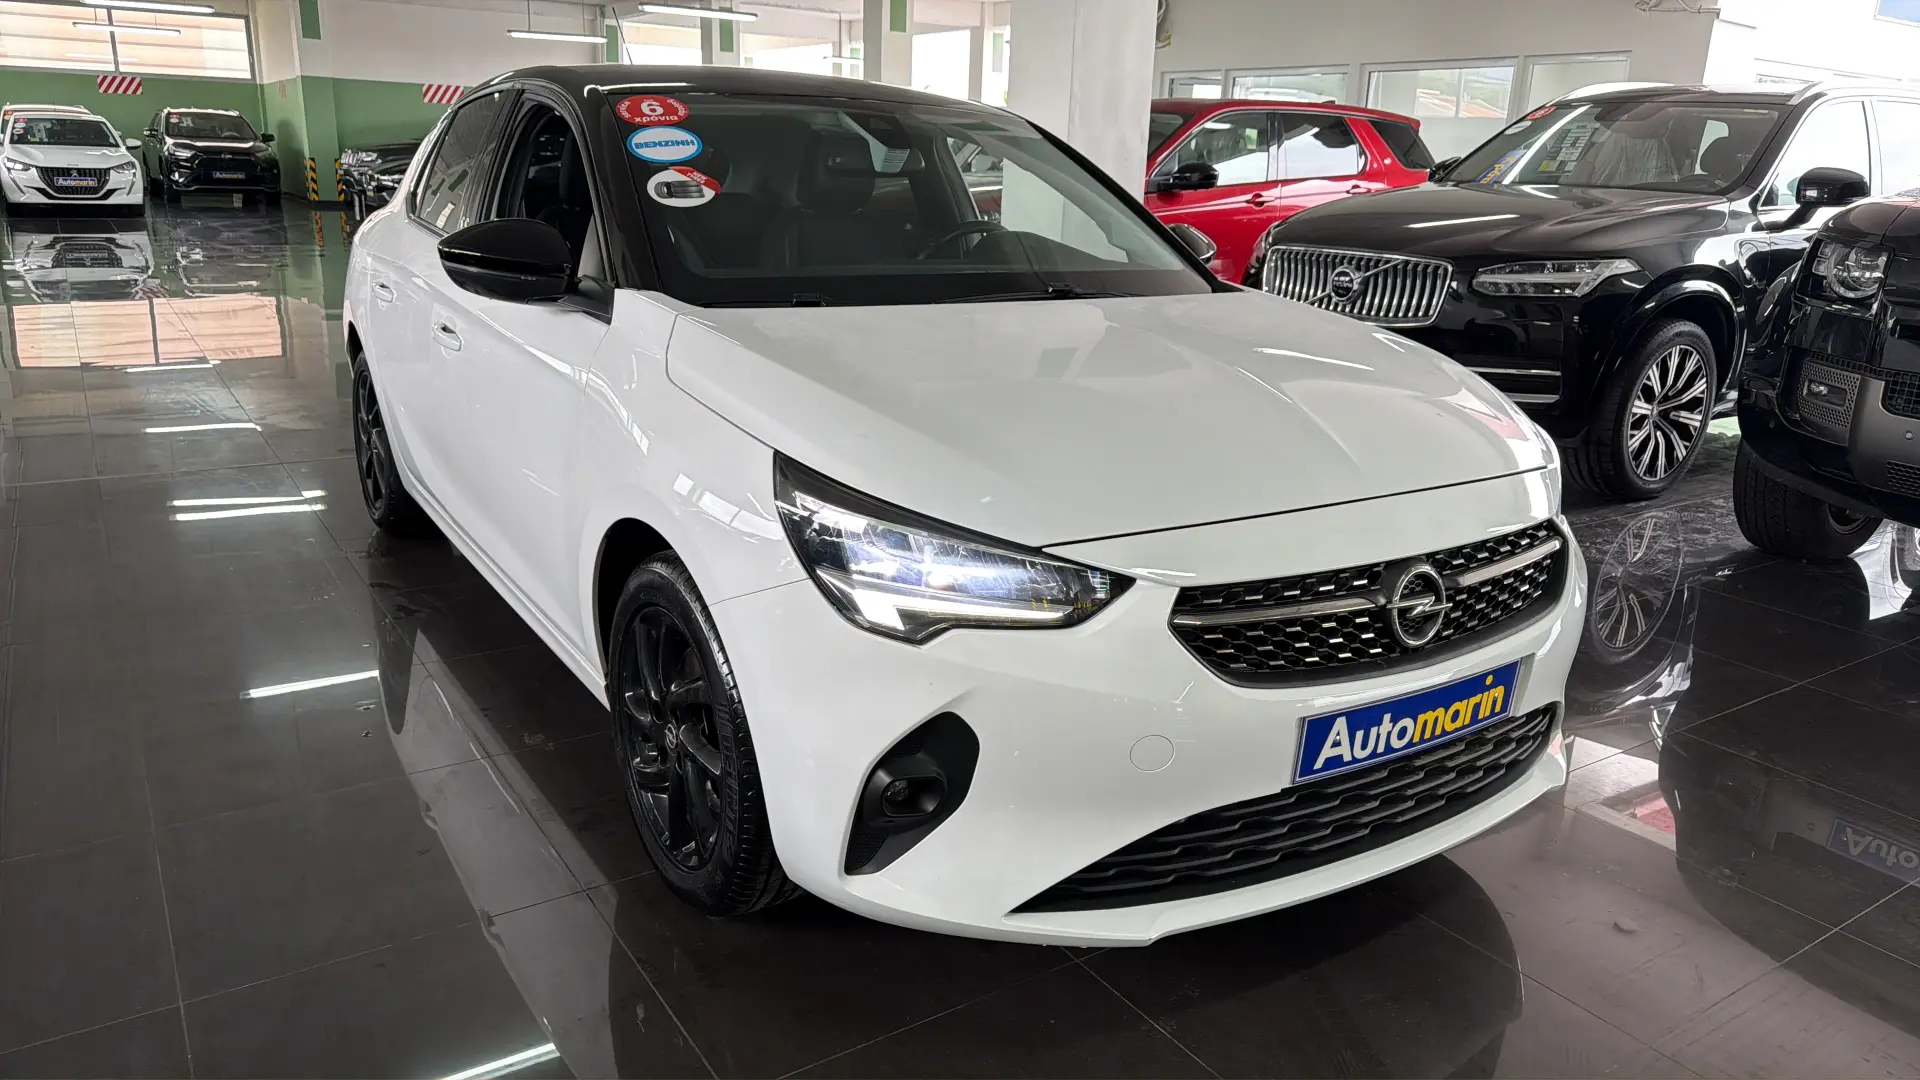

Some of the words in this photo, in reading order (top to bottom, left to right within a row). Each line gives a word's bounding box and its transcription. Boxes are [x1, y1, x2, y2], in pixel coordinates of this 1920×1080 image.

[640, 101, 664, 116] 6
[634, 115, 678, 123] χρόνια
[1313, 674, 1505, 770] Automarin
